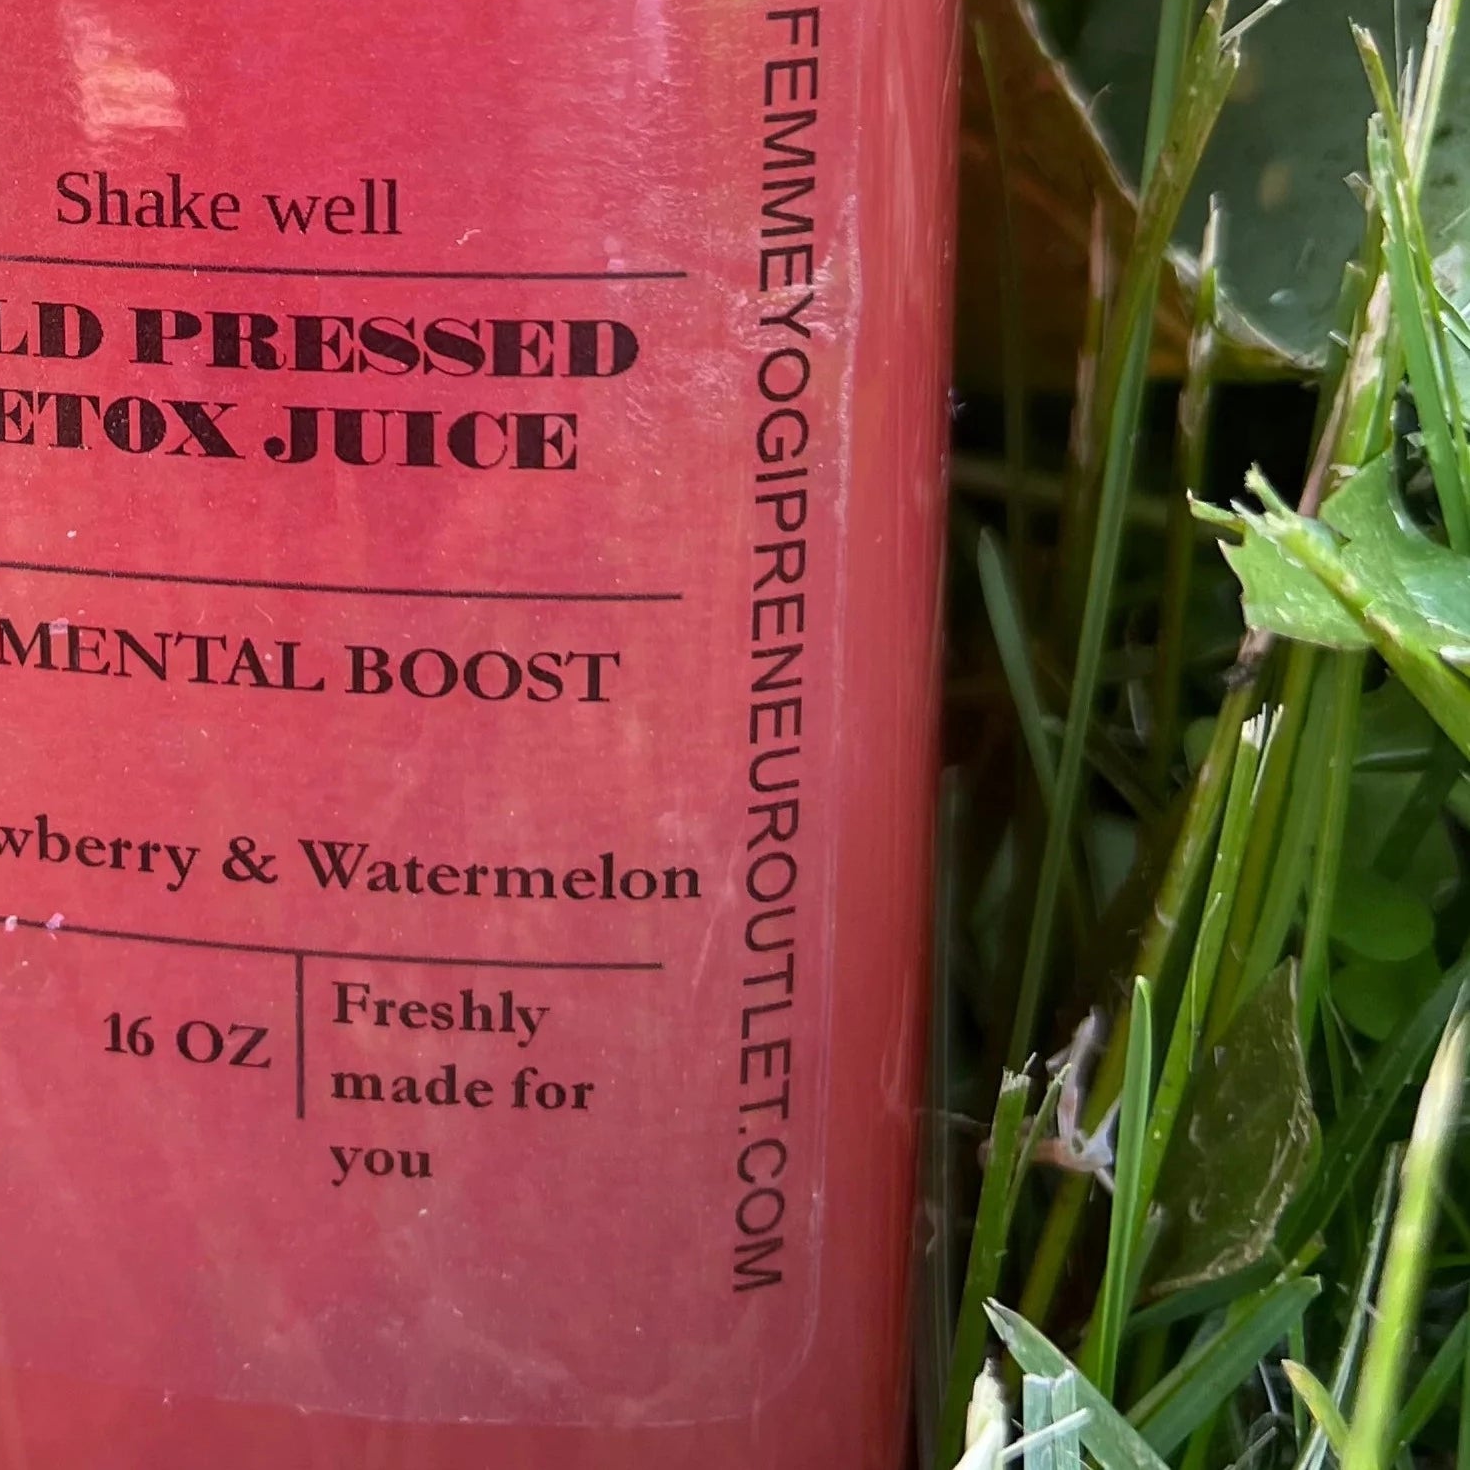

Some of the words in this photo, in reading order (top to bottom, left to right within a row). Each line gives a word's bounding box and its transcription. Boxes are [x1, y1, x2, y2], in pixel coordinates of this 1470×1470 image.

[55, 170, 241, 232] Shake
[262, 177, 403, 235] well
[128, 306, 641, 378] PRESSED
[263, 407, 580, 472] JUICE
[343, 644, 622, 704] BOOST
[733, 5, 821, 1294] FEMMEYOGIPRENEUROUTLET.COM
[220, 835, 279, 886] &
[297, 837, 703, 901] Watermelon
[102, 1010, 156, 1058] 16
[175, 1018, 273, 1070] OZ
[330, 980, 551, 1048] Freshly
[329, 1063, 495, 1110] made
[510, 1065, 596, 1112] for
[329, 1139, 433, 1186] you
